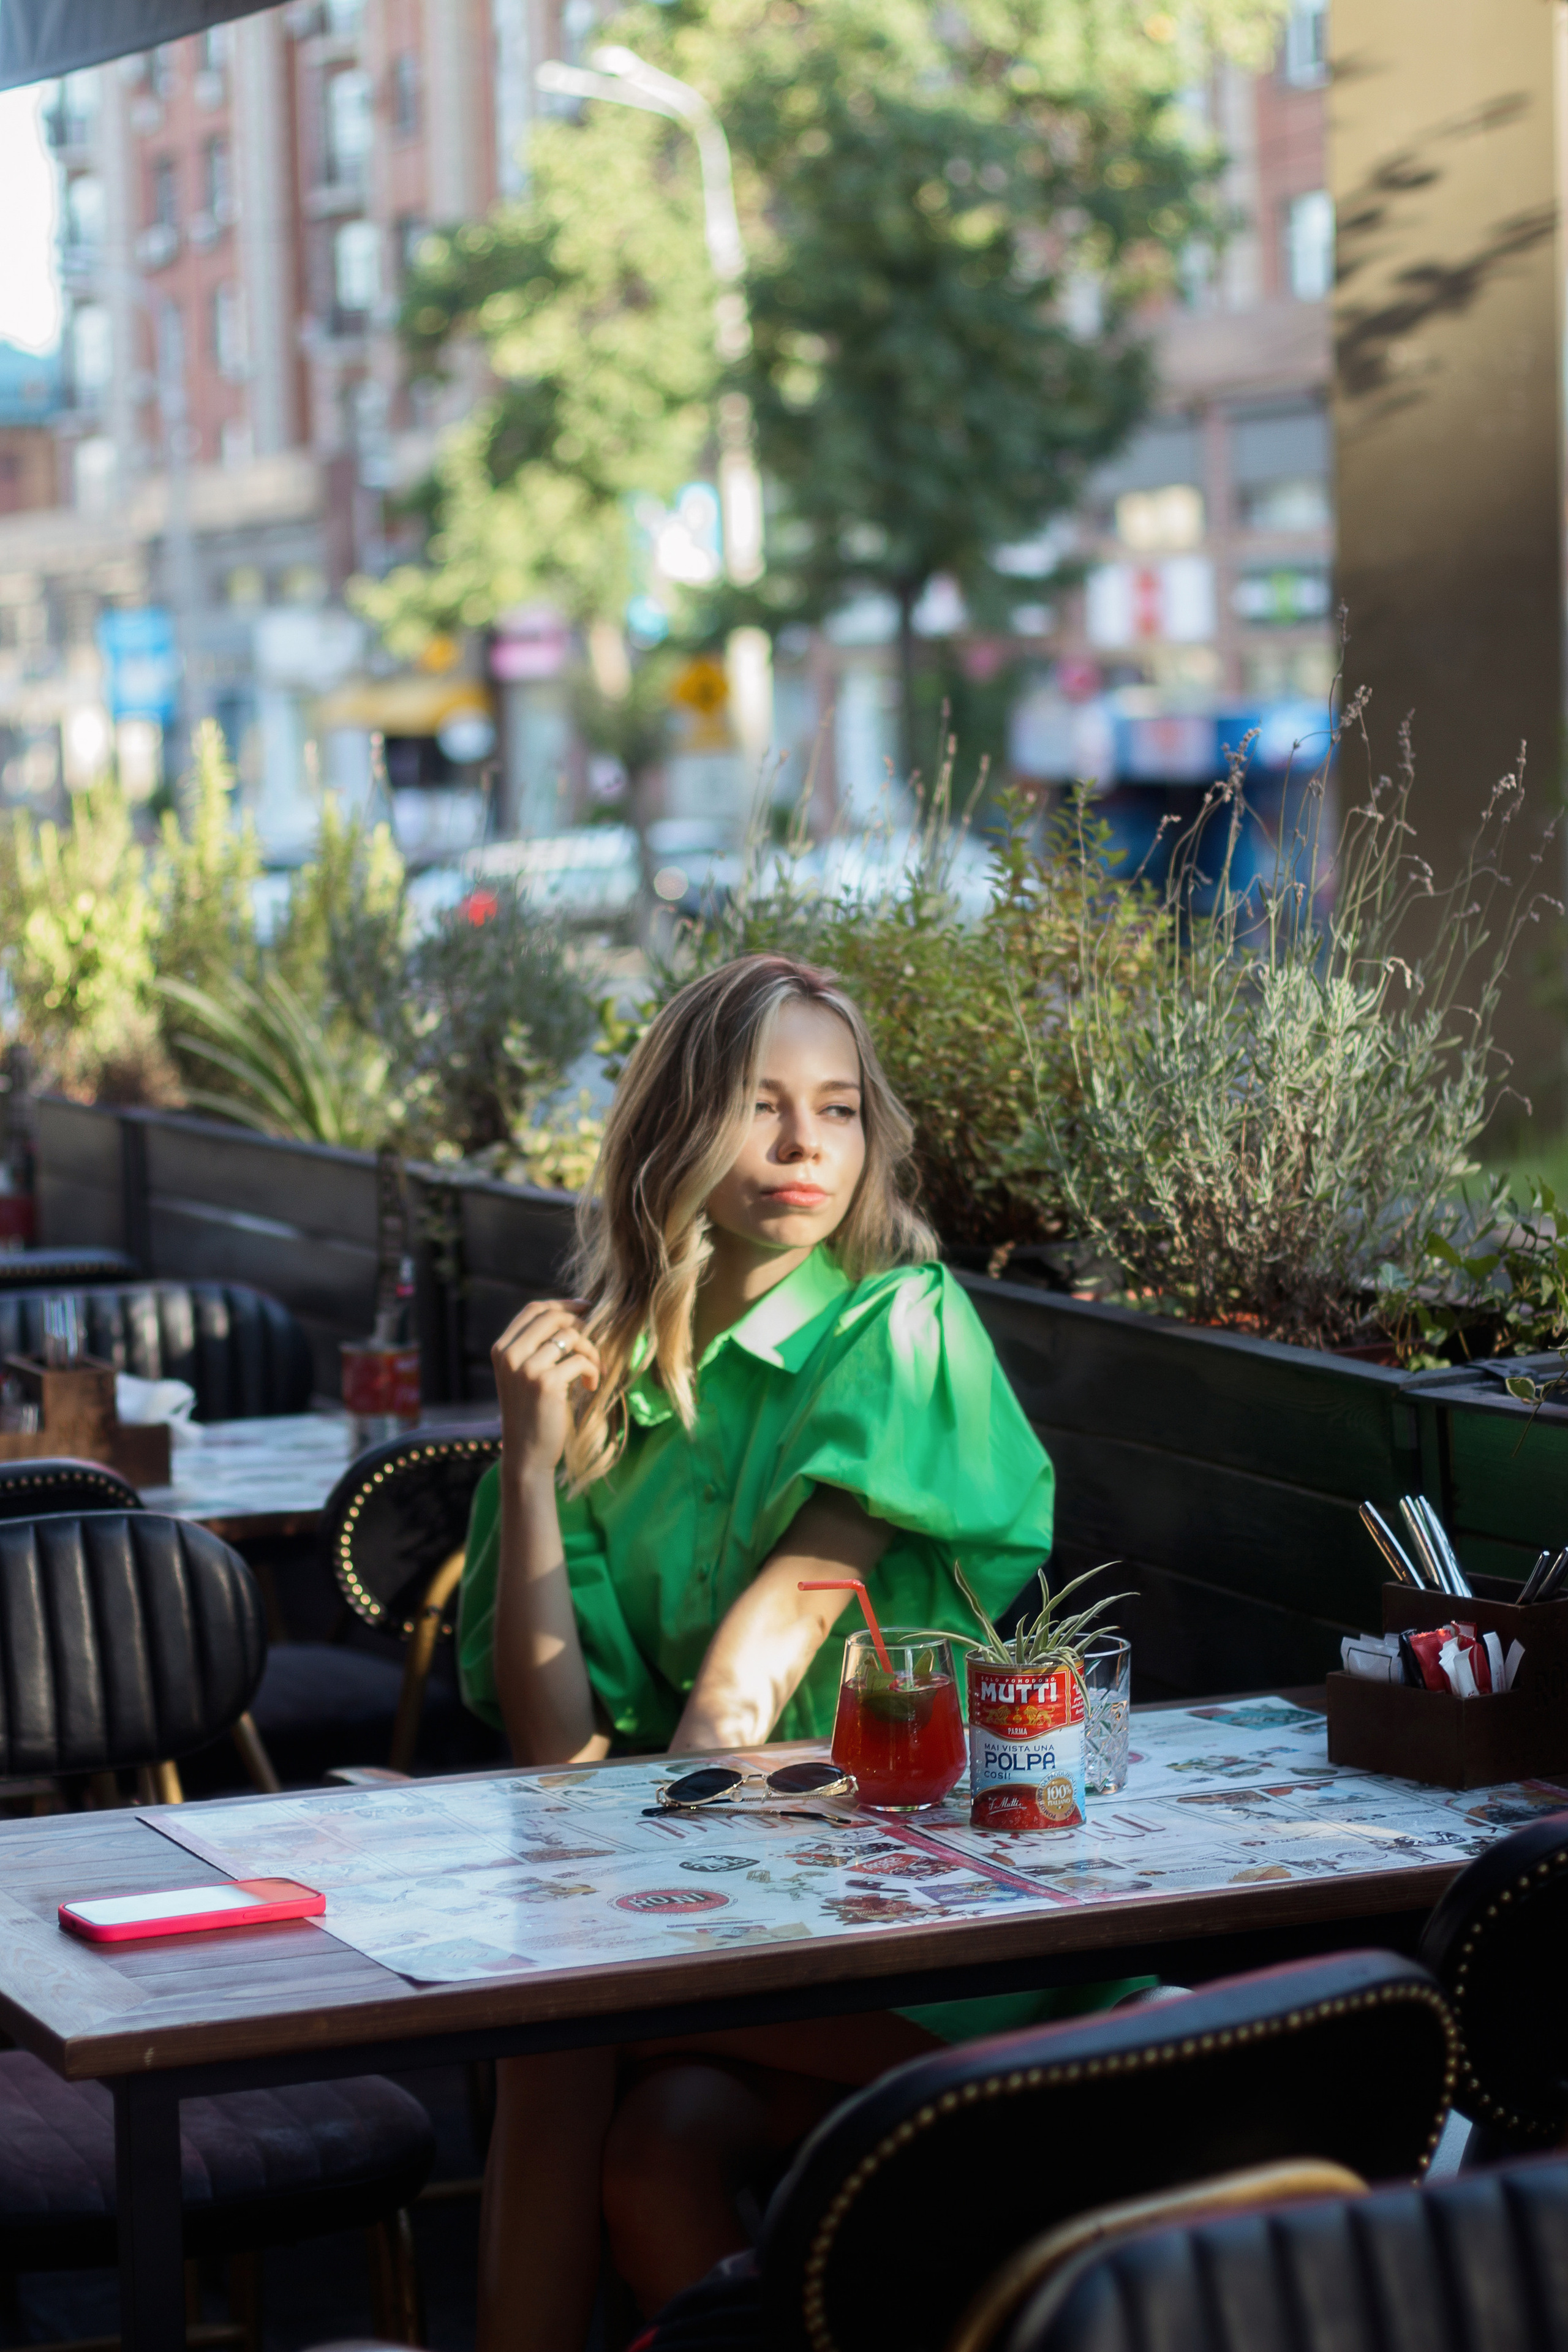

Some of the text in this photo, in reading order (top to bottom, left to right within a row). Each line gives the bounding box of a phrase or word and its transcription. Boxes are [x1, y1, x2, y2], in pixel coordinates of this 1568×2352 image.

[981, 1681, 1057, 1703] MUTTI
[984, 1751, 1056, 1771] POLPA
[1047, 1784, 1072, 1801] 100%
[1047, 1797, 1071, 1806] ITALIANO
[628, 1893, 705, 1909] RONI
